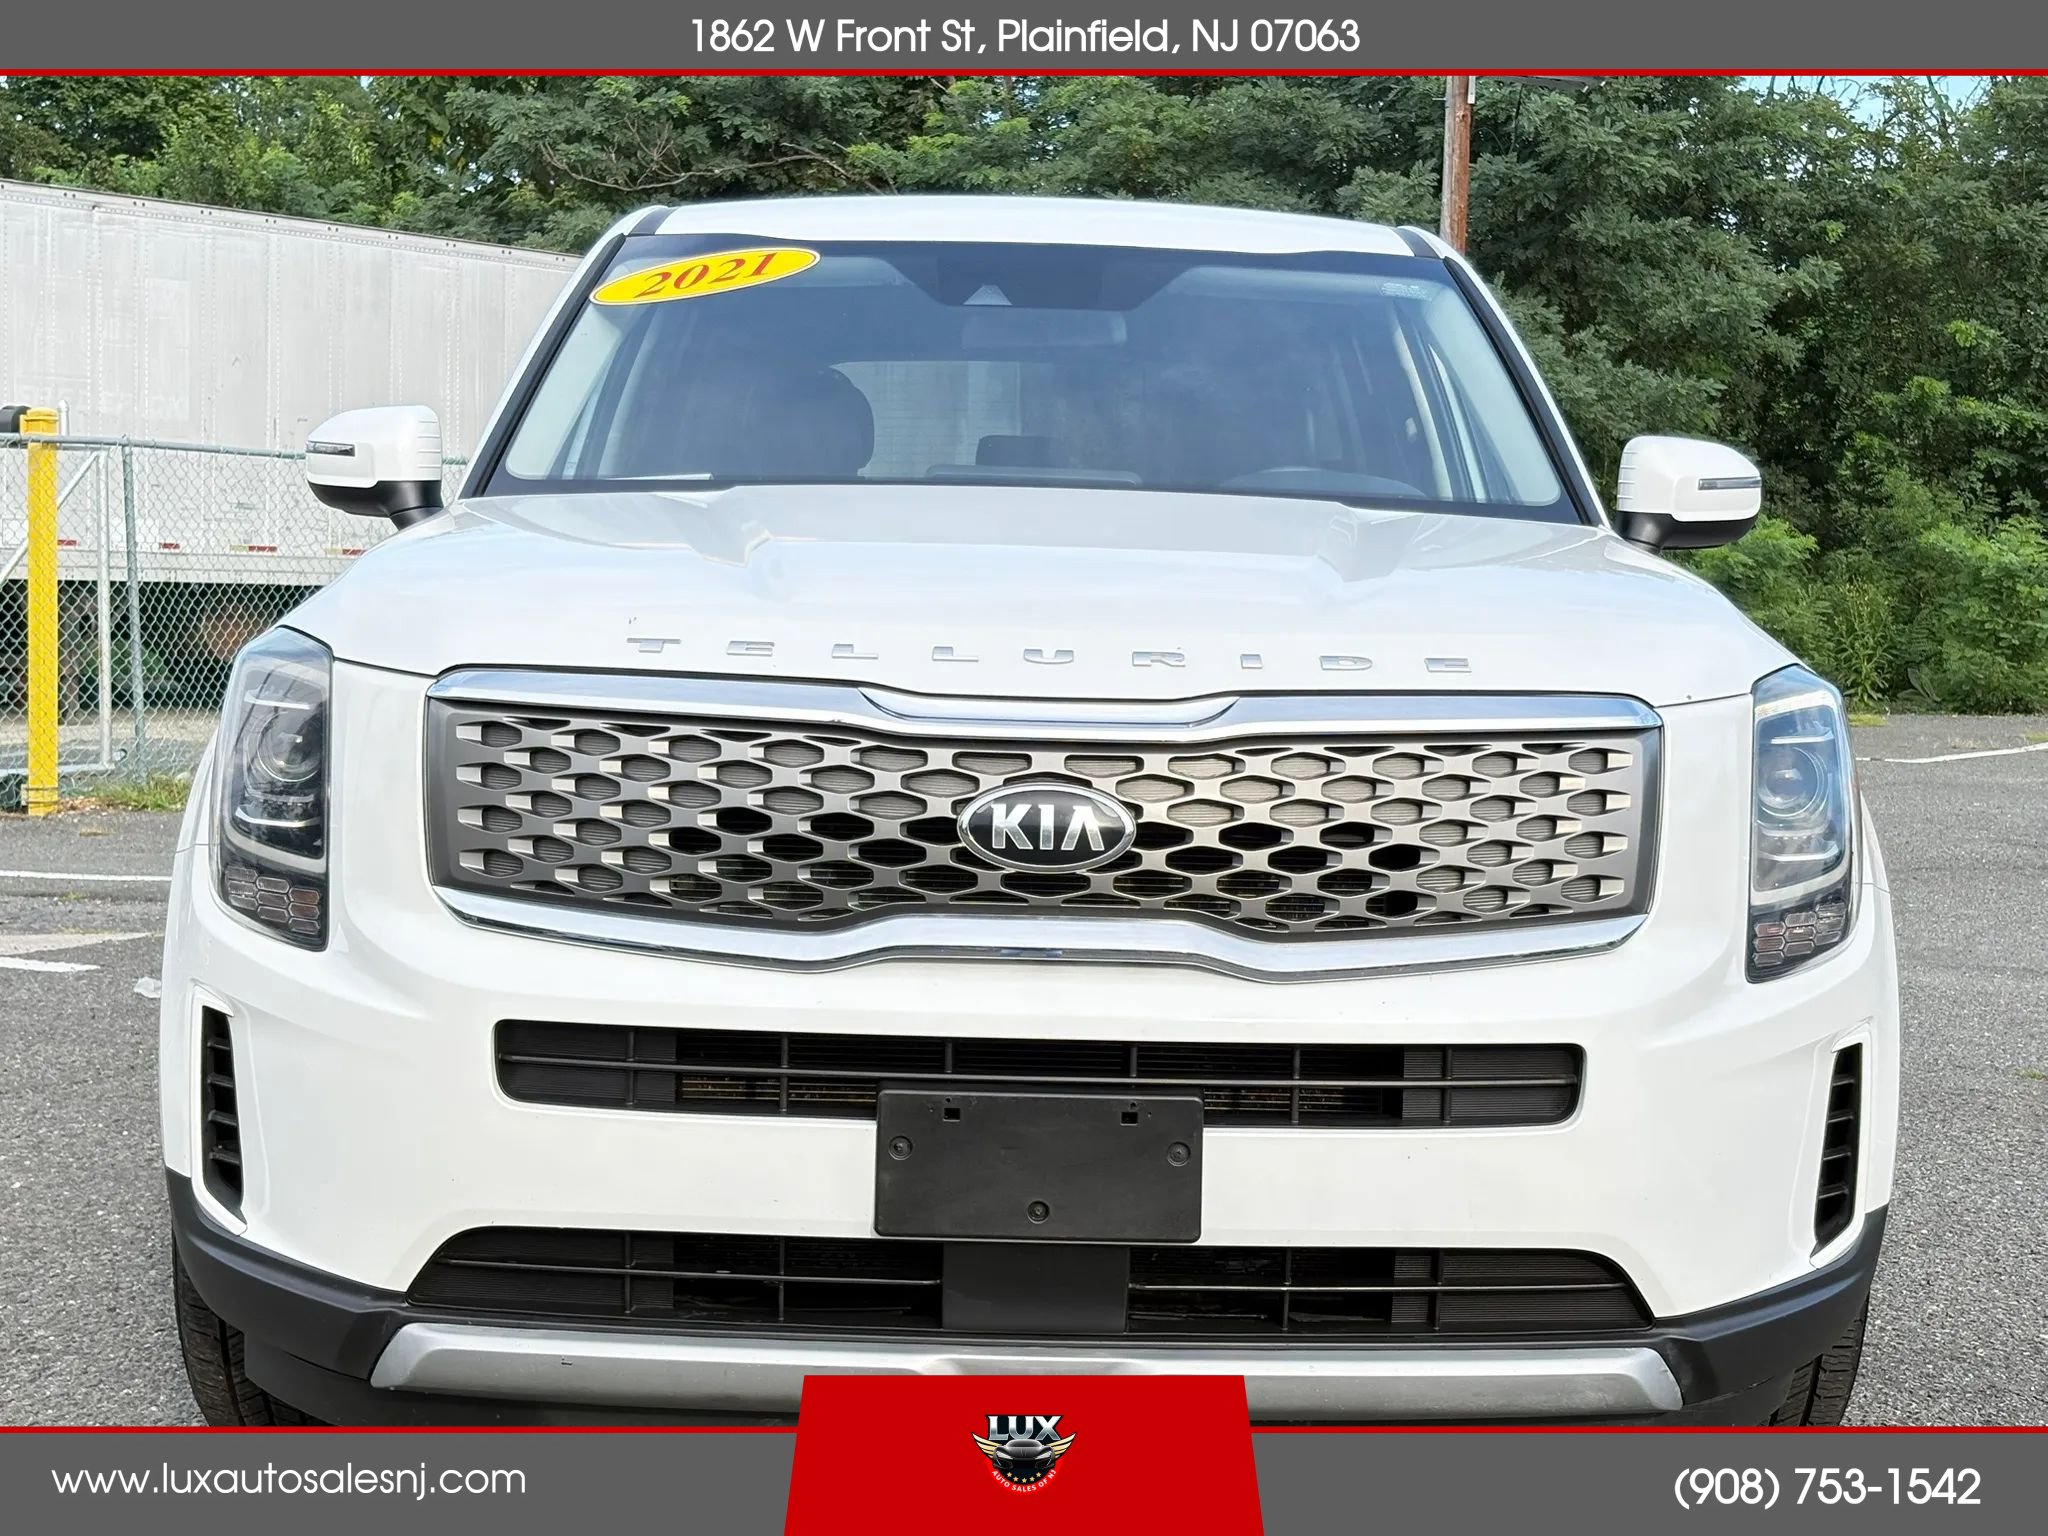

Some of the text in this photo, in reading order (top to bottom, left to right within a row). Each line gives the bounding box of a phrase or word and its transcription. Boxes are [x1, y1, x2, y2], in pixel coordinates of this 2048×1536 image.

[633, 252, 779, 299] 2021
[626, 637, 1473, 673] TELLURIDE
[990, 803, 1106, 852] KIA
